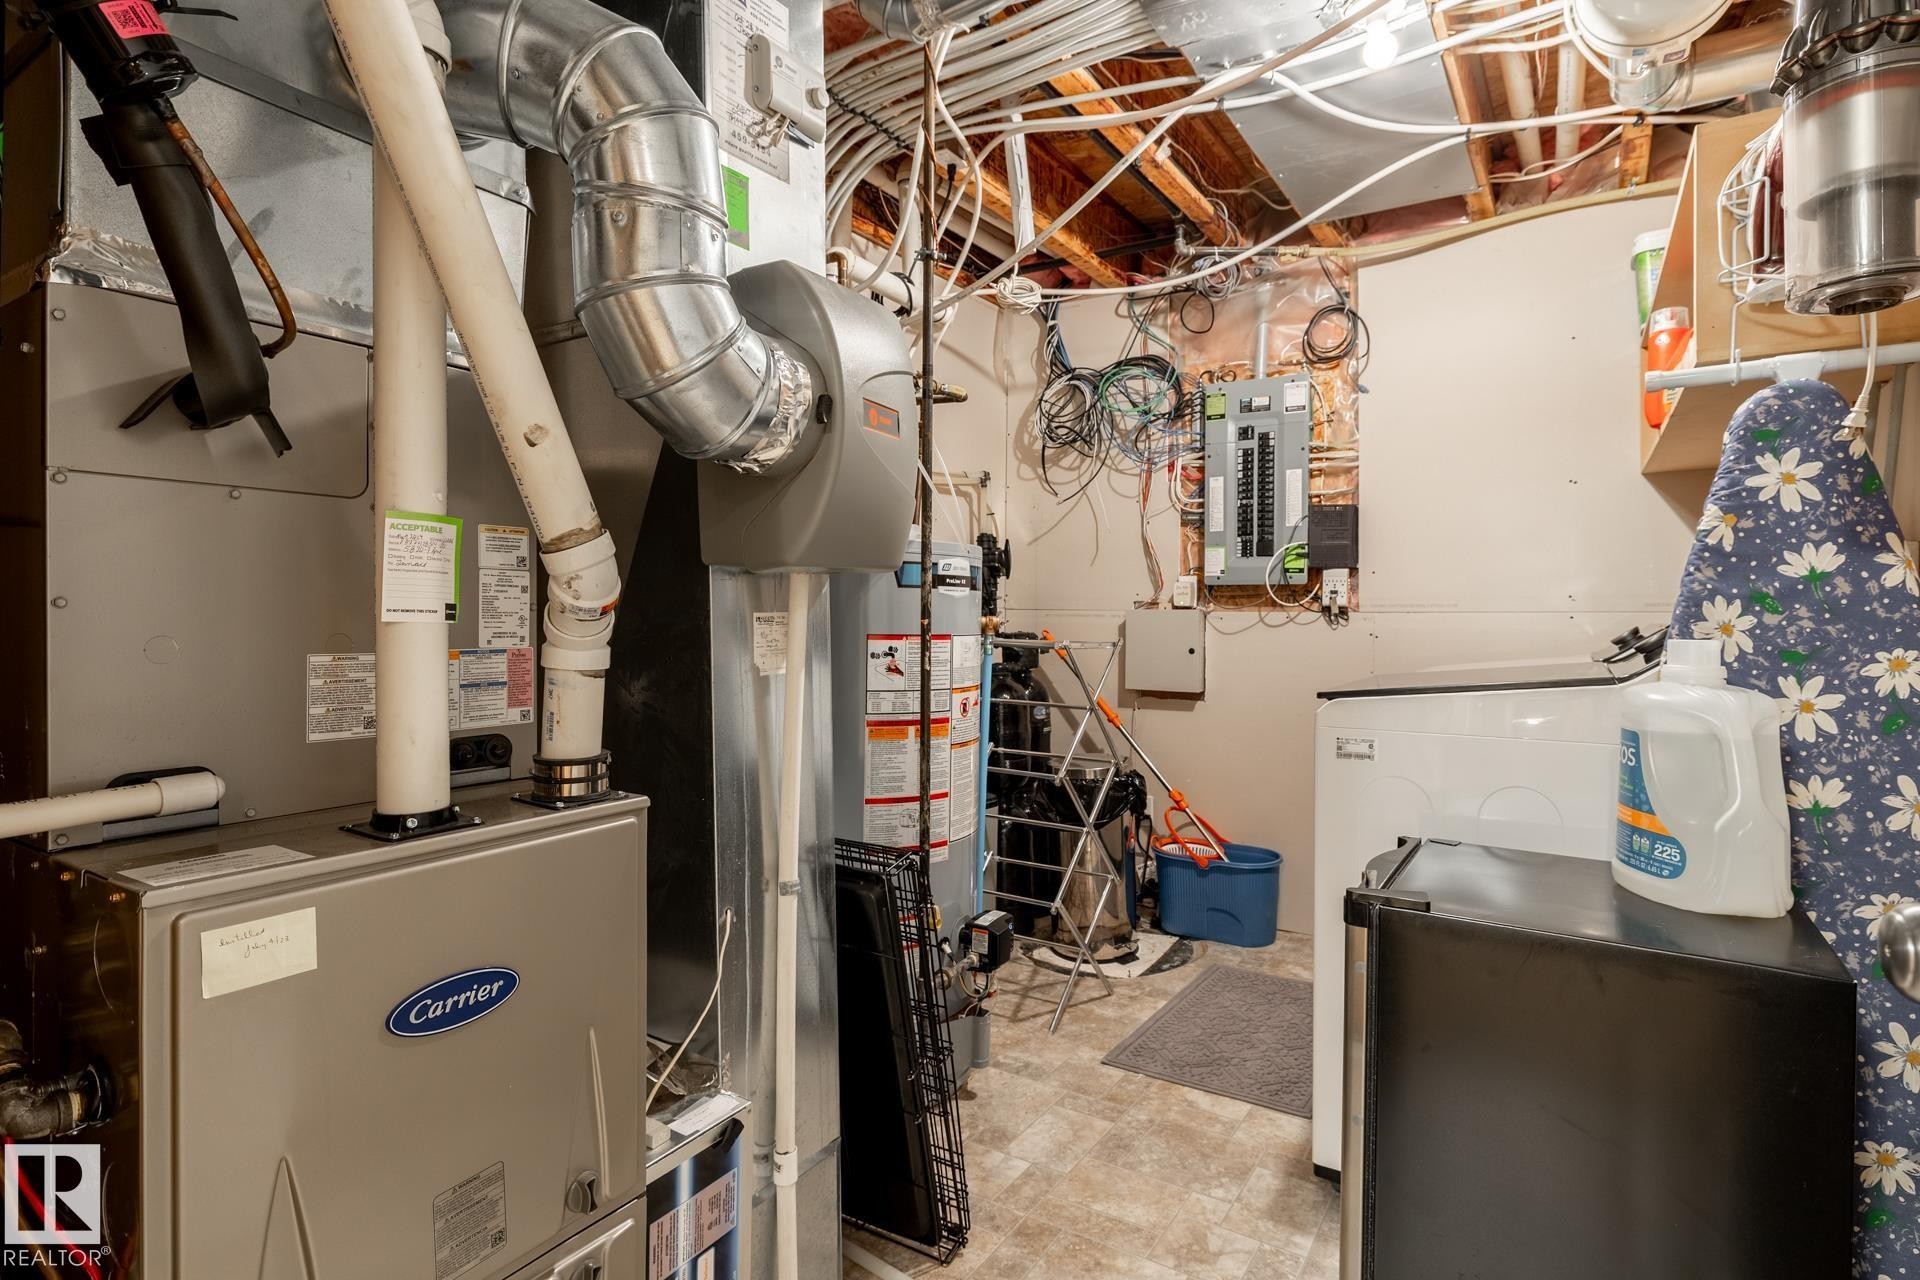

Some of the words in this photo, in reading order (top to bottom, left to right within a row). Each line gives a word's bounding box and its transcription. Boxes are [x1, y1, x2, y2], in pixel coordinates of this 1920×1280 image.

[389, 522, 443, 534] ACCEPTABLE
[1653, 843, 1681, 862] 225
[409, 979, 504, 1024] Carrier
